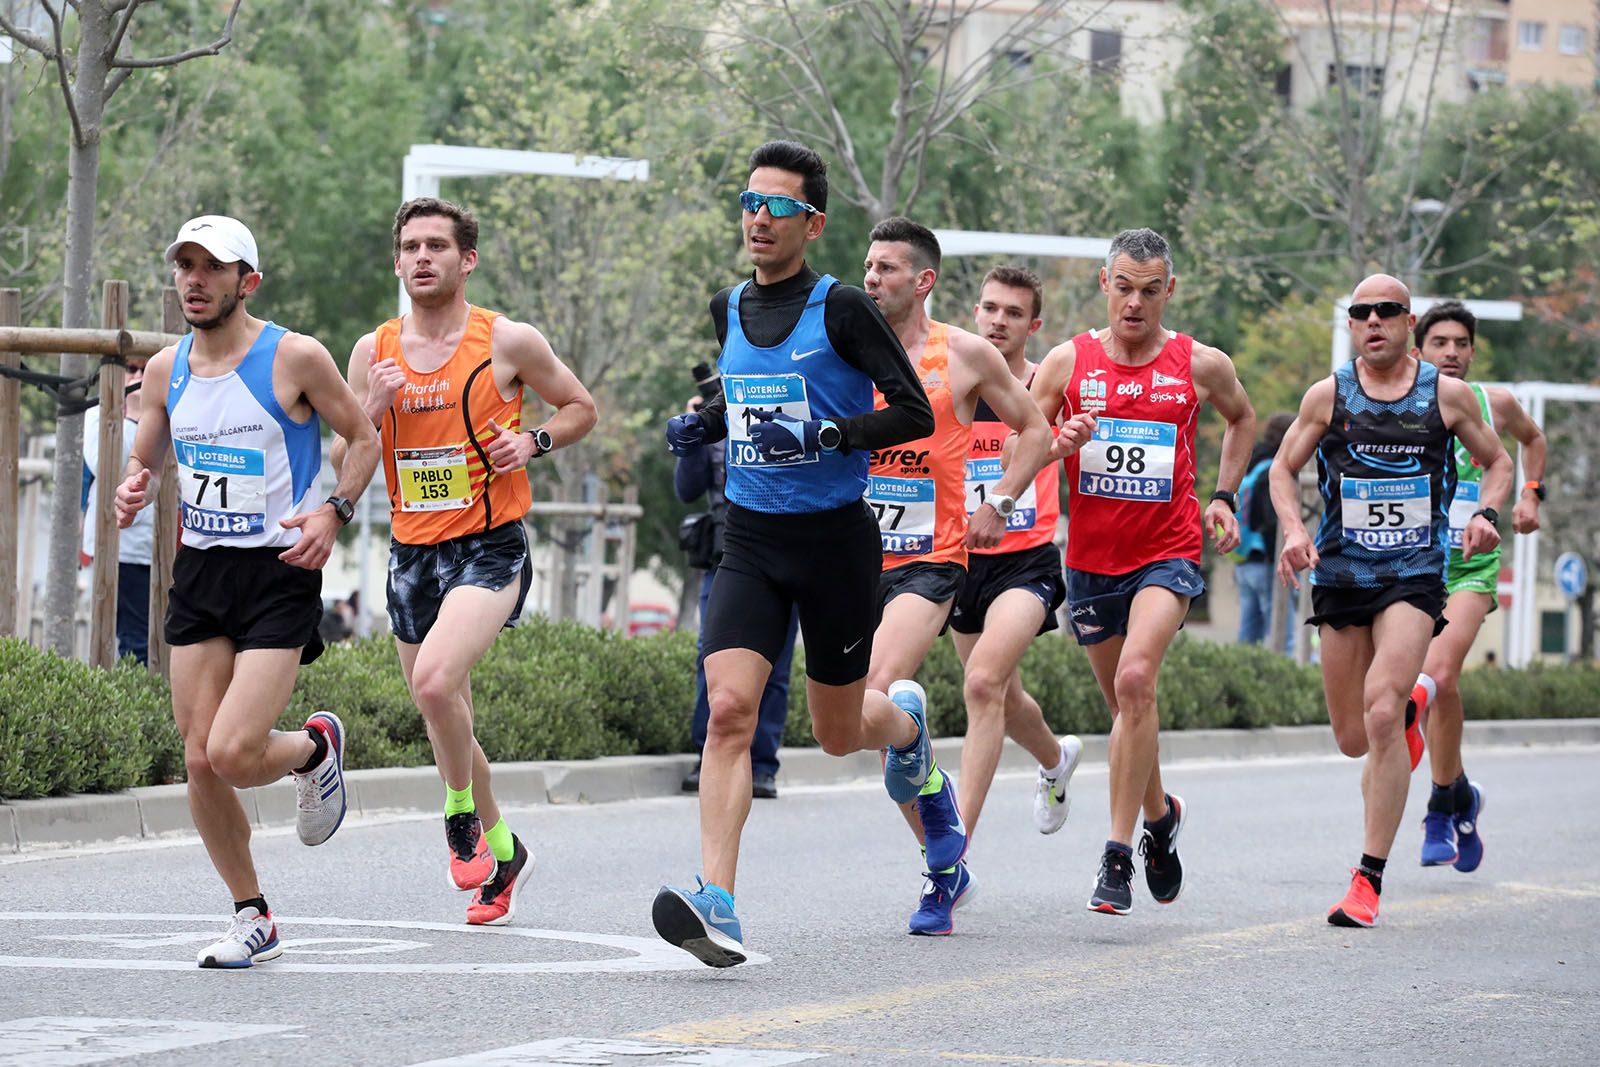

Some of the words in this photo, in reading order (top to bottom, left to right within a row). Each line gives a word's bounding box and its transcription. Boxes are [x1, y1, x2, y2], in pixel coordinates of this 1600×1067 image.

[746, 383, 788, 394] LOTERÍAS
[1116, 381, 1143, 399] edp
[1115, 426, 1160, 437] LOTERÍAS
[972, 439, 1003, 452] ALB
[199, 452, 246, 464] LOTERÍAS
[869, 449, 930, 466] errer
[1106, 445, 1146, 475] 98
[413, 469, 453, 483] PABLO
[900, 466, 922, 475] sport
[193, 473, 228, 508] 71
[420, 483, 449, 499] 153
[875, 483, 918, 493] LOTERÍAS
[1087, 475, 1160, 496] Joma
[1373, 484, 1416, 493] LOTERÍAS
[184, 508, 252, 533] Joma
[1368, 503, 1405, 528] 55
[881, 534, 921, 552] ma
